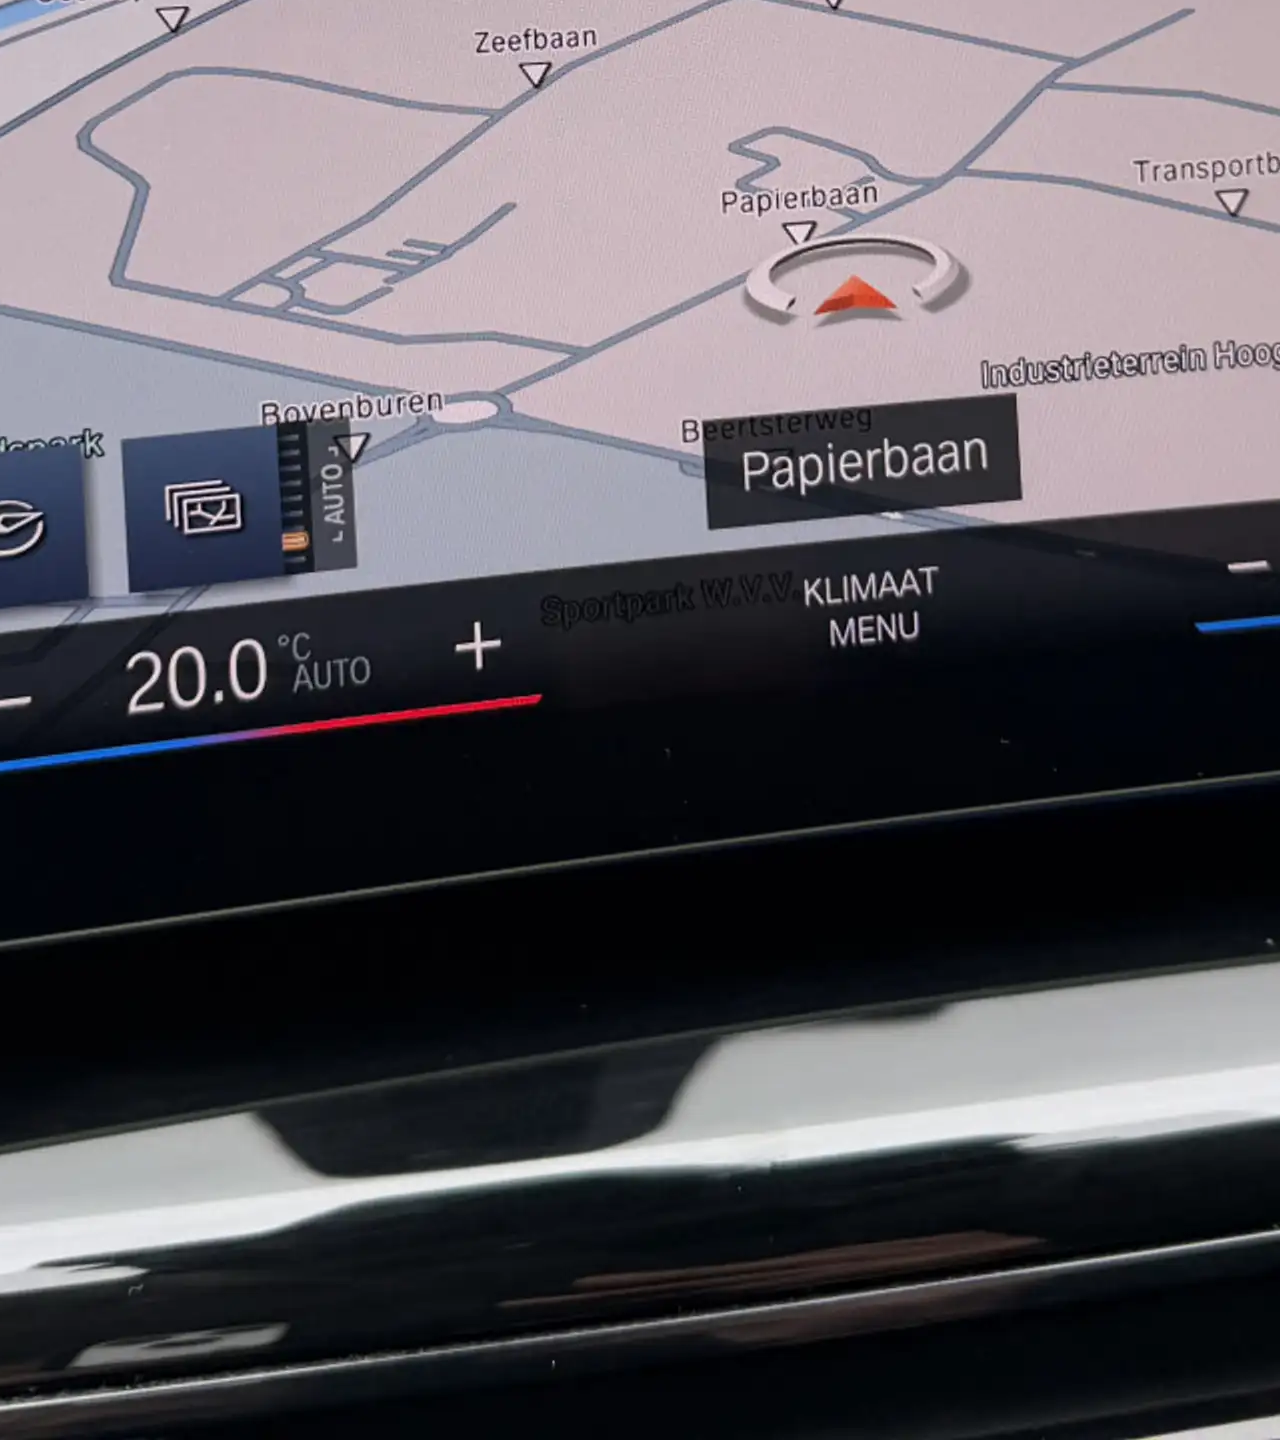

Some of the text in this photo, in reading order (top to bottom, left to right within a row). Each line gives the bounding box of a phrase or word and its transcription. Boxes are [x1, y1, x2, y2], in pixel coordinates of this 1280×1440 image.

[475, 25, 597, 56] Zeefbaan
[722, 180, 877, 215] Papierbaan
[982, 342, 1207, 388] Industrieterrein
[261, 388, 443, 426] Bovenburen
[682, 406, 873, 444] Beertsterweg
[742, 433, 988, 496] Papierbaan
[322, 463, 344, 525] AUTO
[803, 565, 939, 607] KLIMAAT
[829, 611, 920, 648] MENU
[127, 637, 268, 716] 20.0
[293, 656, 371, 693] AUTO
